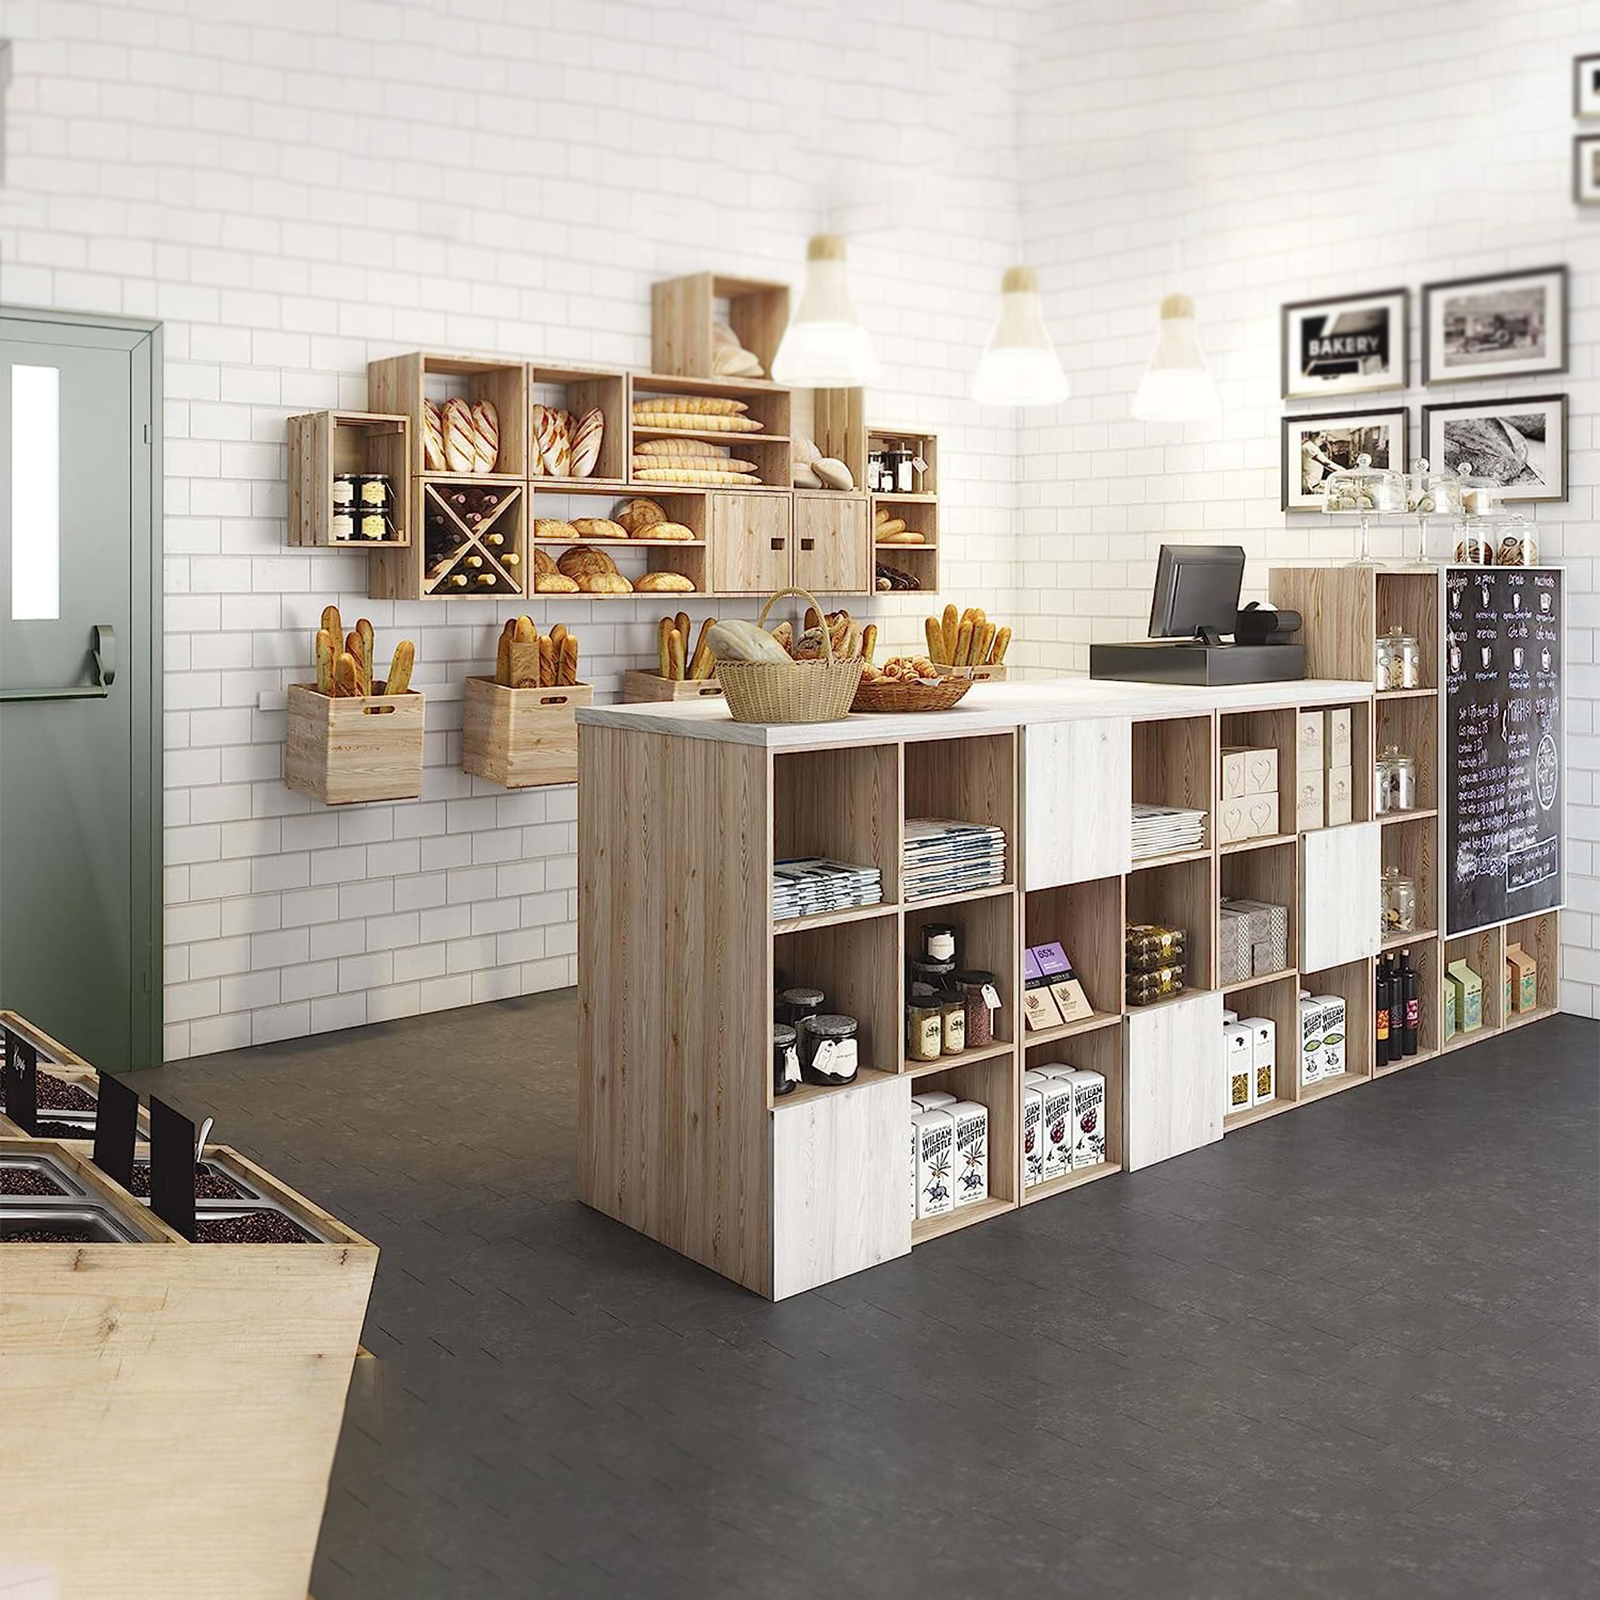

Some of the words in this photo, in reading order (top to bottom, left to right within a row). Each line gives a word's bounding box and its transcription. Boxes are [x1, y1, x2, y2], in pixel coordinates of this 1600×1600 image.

[1308, 336, 1380, 357] BAKERY
[1045, 1095, 1070, 1117] WILLIAM
[1075, 1085, 1103, 1106] WILLIAM
[1075, 1094, 1103, 1118] WHISTLE
[1045, 1103, 1070, 1129] WHISTLE
[922, 1128, 952, 1151] WILLIAM
[957, 1117, 986, 1140] WILLIAM
[957, 1126, 986, 1152] WHISTLE
[922, 1137, 952, 1163] WHISTLE
